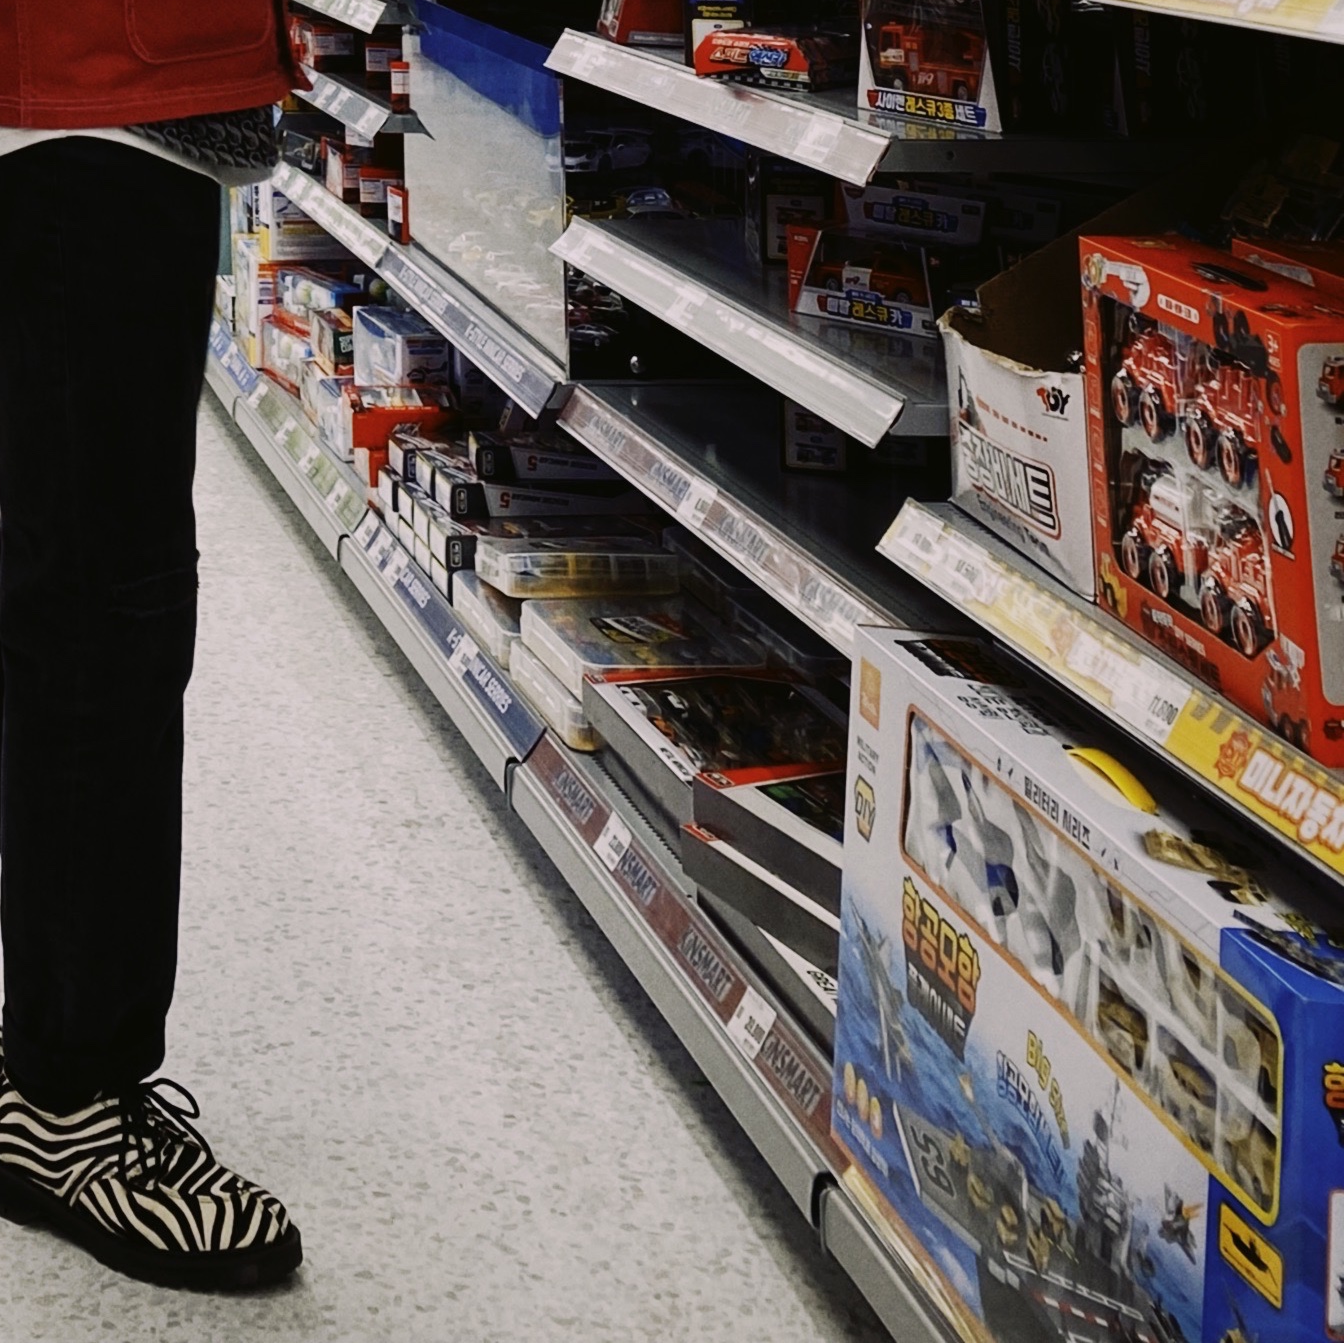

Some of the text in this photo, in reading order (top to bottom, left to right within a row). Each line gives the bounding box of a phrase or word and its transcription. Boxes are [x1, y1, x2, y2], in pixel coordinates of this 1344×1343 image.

[1036, 386, 1071, 415] TOY
[484, 673, 512, 714] SERIES
[856, 790, 875, 824] DIY
[1024, 774, 1091, 851] 밀리터리 시리즈
[902, 877, 982, 1016] 항공모함
[1026, 1029, 1053, 1092] Big
